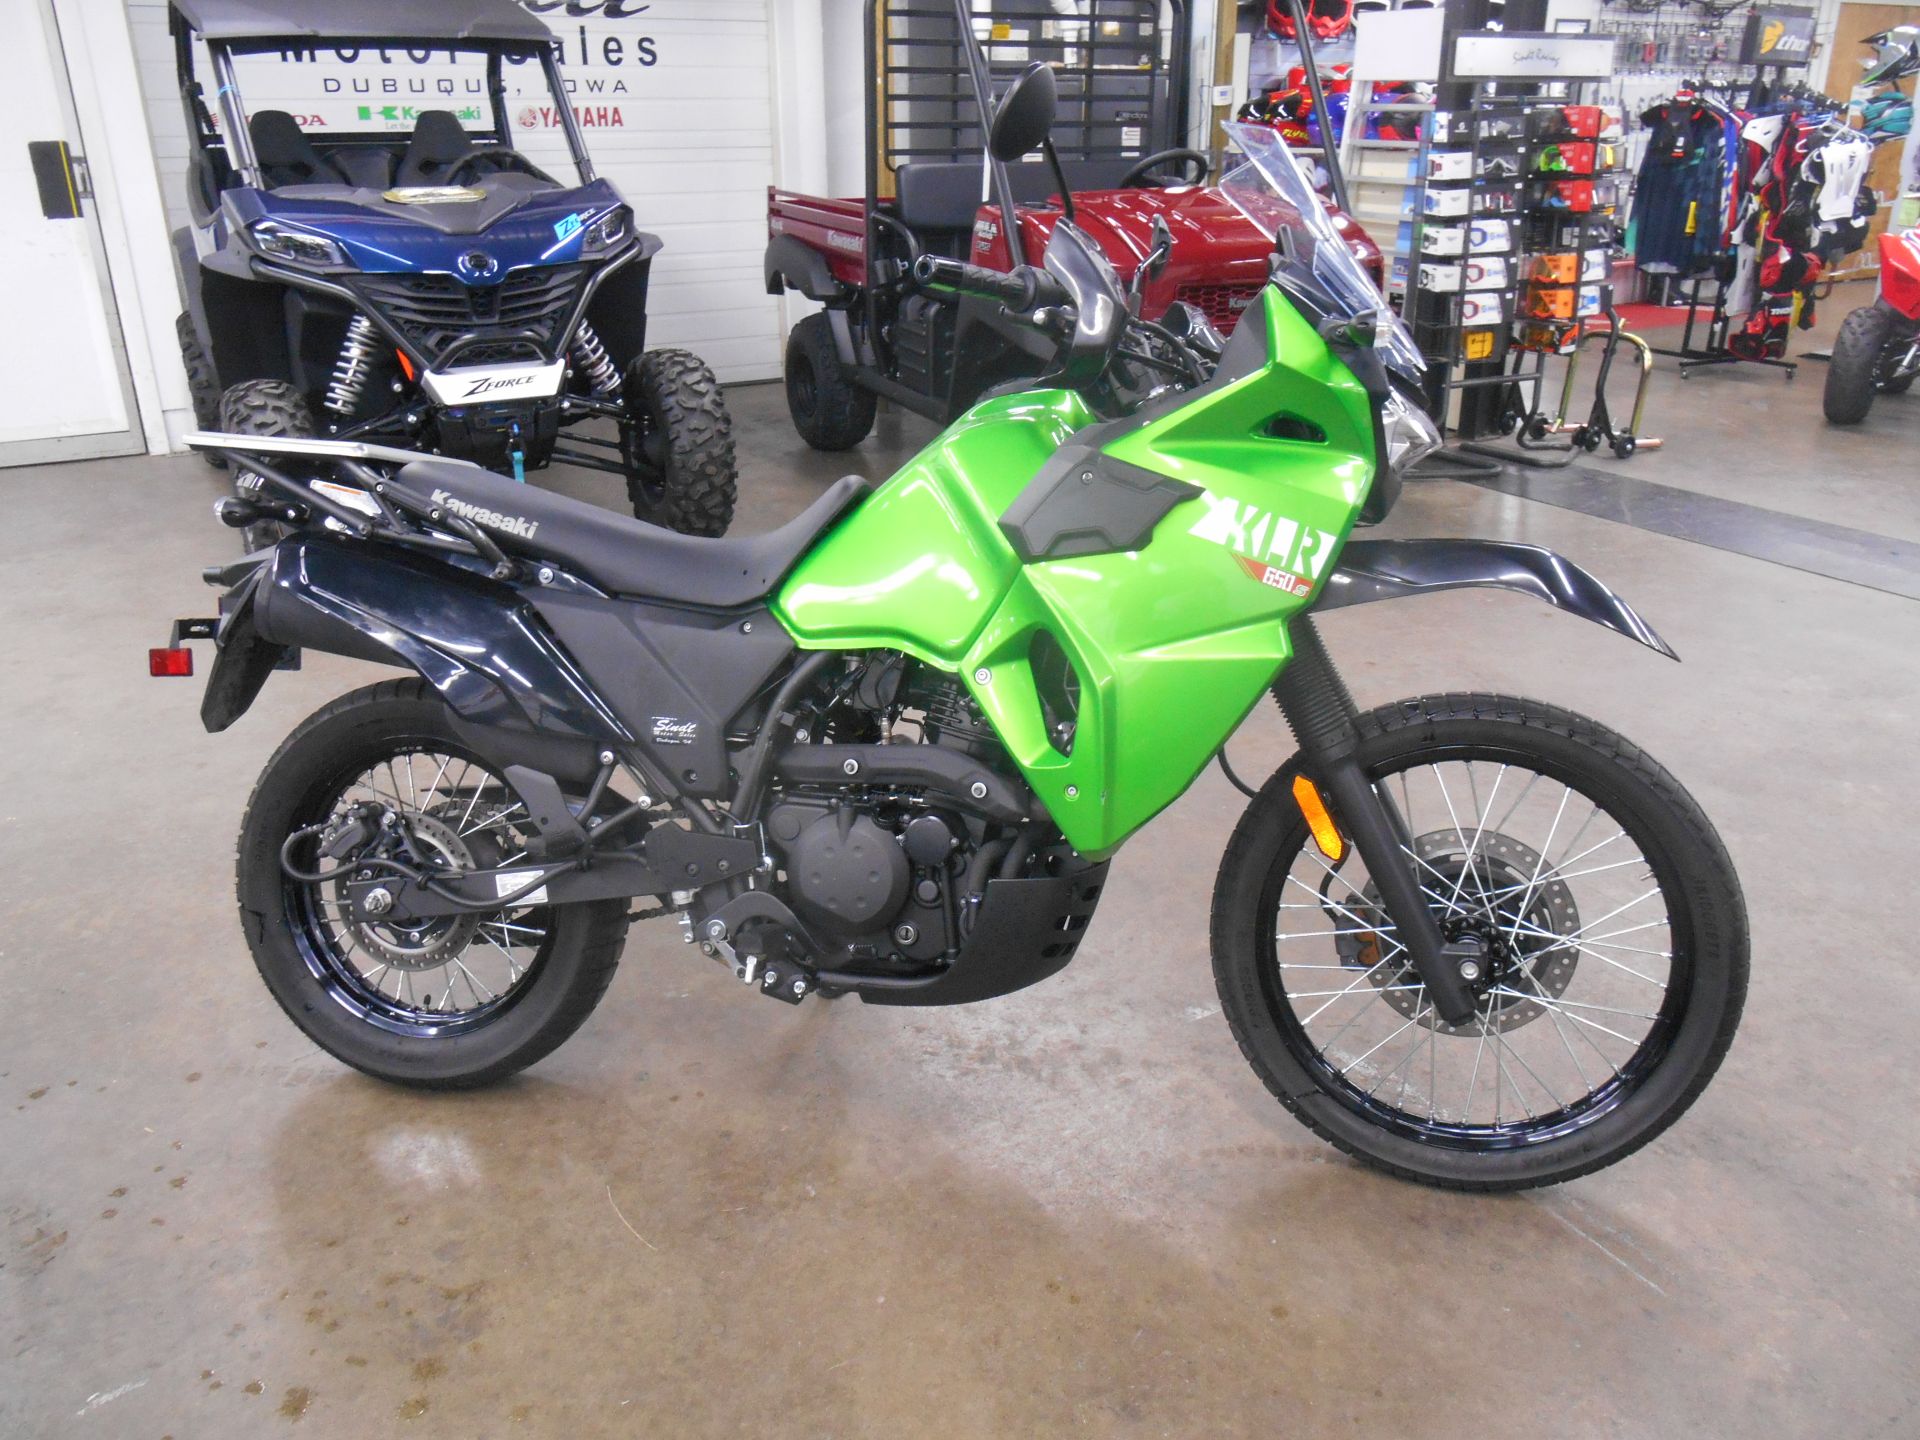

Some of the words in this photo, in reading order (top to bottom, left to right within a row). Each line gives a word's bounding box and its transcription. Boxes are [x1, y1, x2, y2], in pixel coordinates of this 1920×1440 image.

[539, 106, 624, 128] YAAHA
[430, 488, 540, 540] Kawasaki
[1222, 498, 1337, 581] KLR
